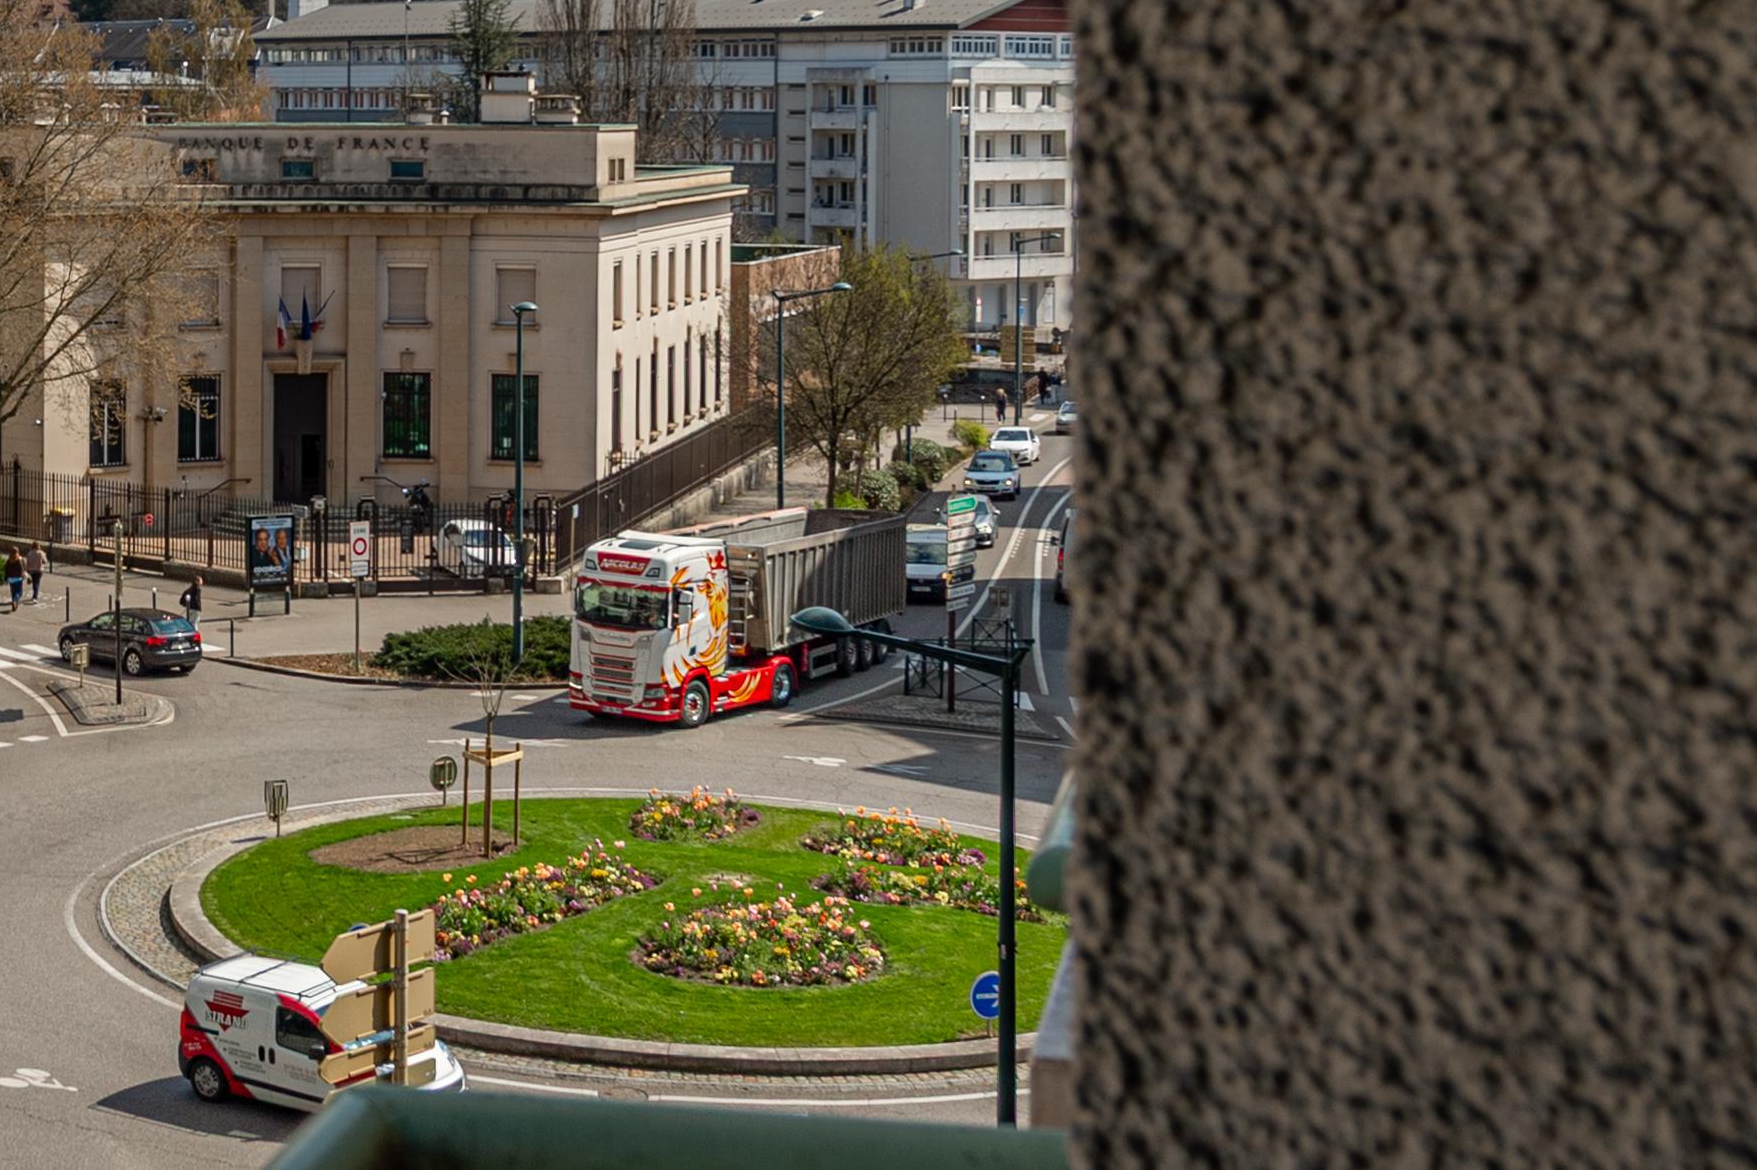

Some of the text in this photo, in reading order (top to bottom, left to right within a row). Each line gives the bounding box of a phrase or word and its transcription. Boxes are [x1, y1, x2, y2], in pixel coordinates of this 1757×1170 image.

[178, 137, 430, 151] BANQUE DE FRANCE
